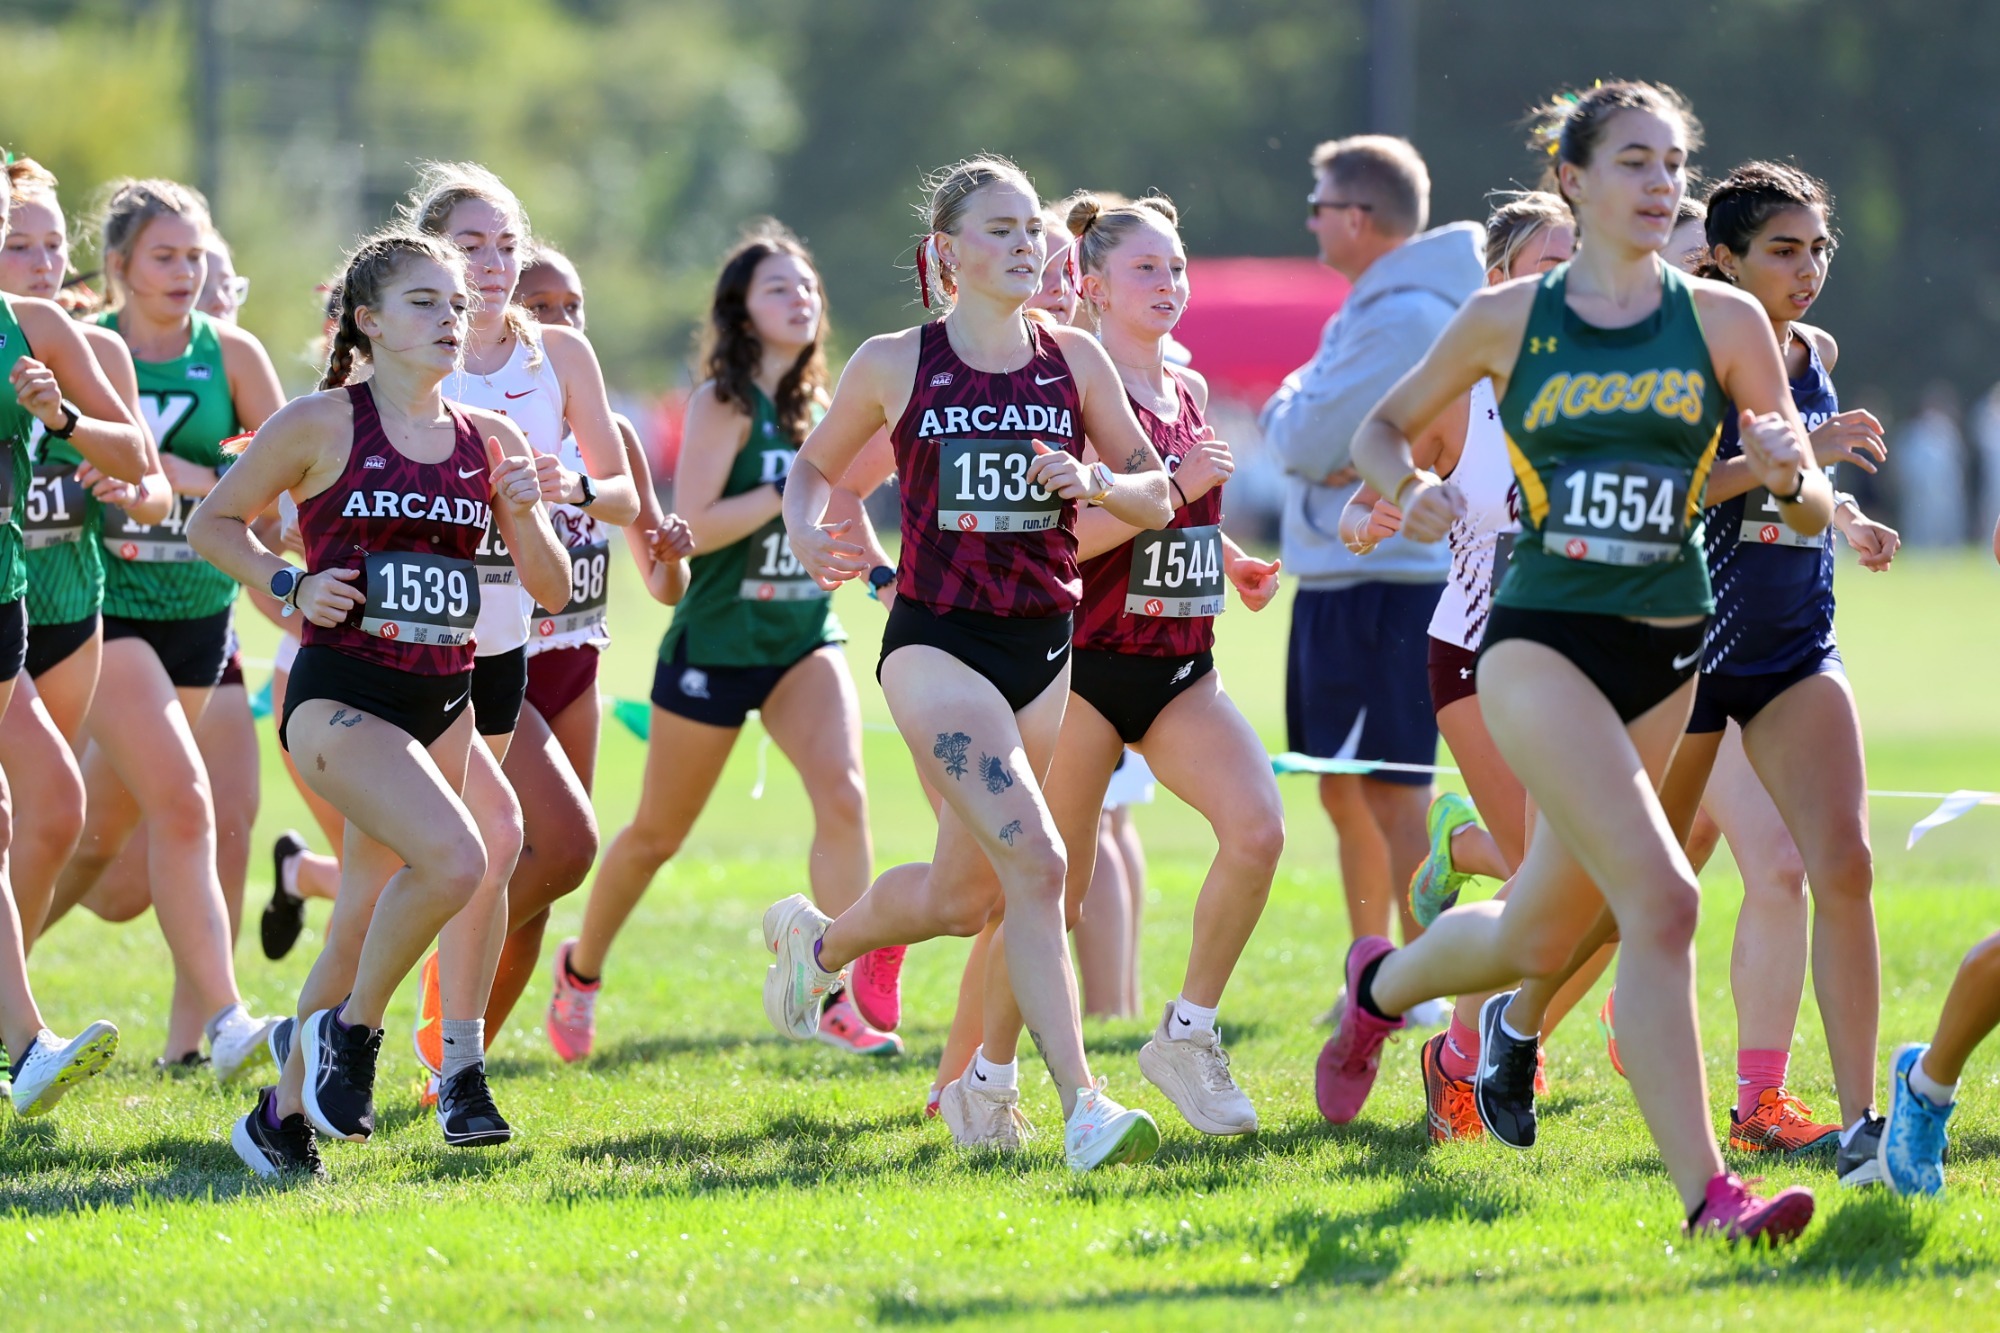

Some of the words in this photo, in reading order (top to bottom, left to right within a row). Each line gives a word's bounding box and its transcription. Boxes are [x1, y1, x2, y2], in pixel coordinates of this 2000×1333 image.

[918, 404, 1073, 438] ARCADIA
[1523, 368, 1705, 433] AGGIES
[27, 476, 70, 522] 51
[1563, 470, 1675, 535] 1554
[960, 514, 975, 530] NT
[1022, 515, 1052, 530] run.tf
[1761, 527, 1776, 542] NT
[484, 570, 513, 584] run.tf
[759, 532, 807, 577] 15
[1143, 538, 1220, 588] 1544
[379, 562, 469, 618] 1539
[572, 554, 606, 604] 98
[1147, 603, 1161, 615] NT
[1200, 599, 1219, 615] run.tf
[382, 623, 396, 638] NT
[437, 632, 464, 645] run.tf
